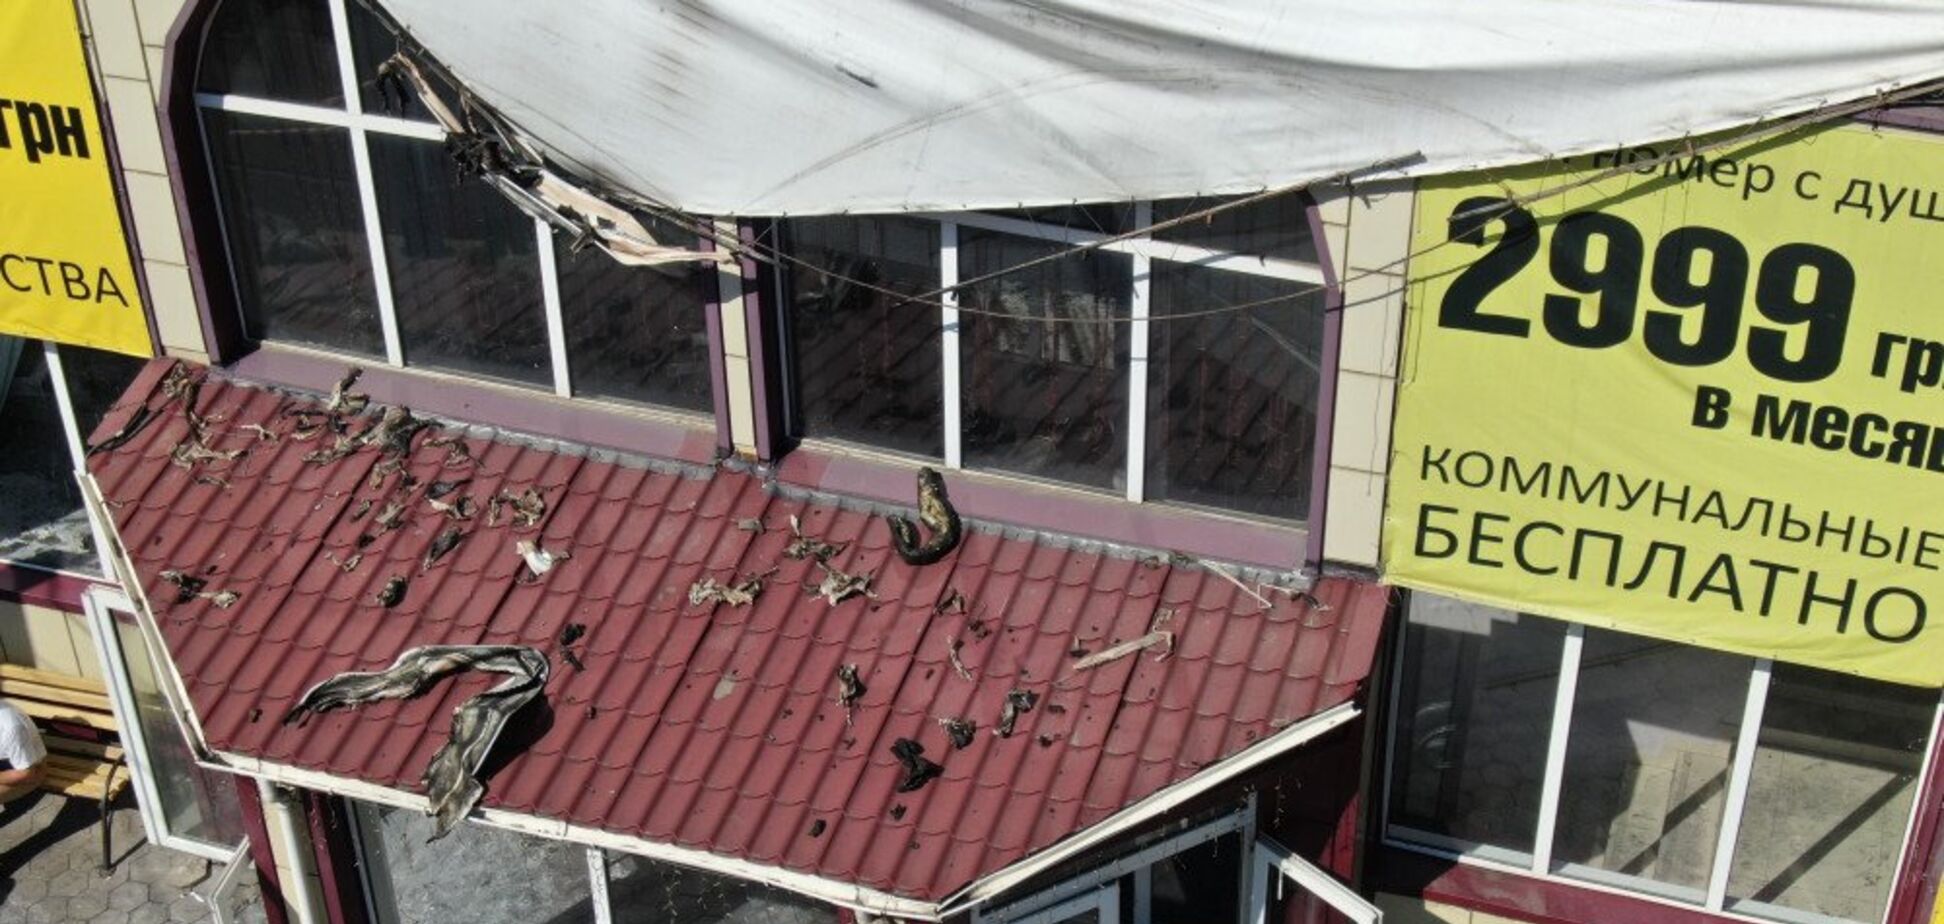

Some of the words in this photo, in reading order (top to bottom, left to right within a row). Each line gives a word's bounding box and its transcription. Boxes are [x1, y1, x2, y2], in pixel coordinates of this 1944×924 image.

[1794, 170, 1822, 200] с
[0, 254, 129, 308] СТВА
[1438, 196, 1856, 383] 2999
[1691, 385, 1732, 430] в
[1420, 444, 1944, 571] КОММУНАЛЬНЫЕ
[1413, 503, 1928, 644] БЕСПЛАТНО
